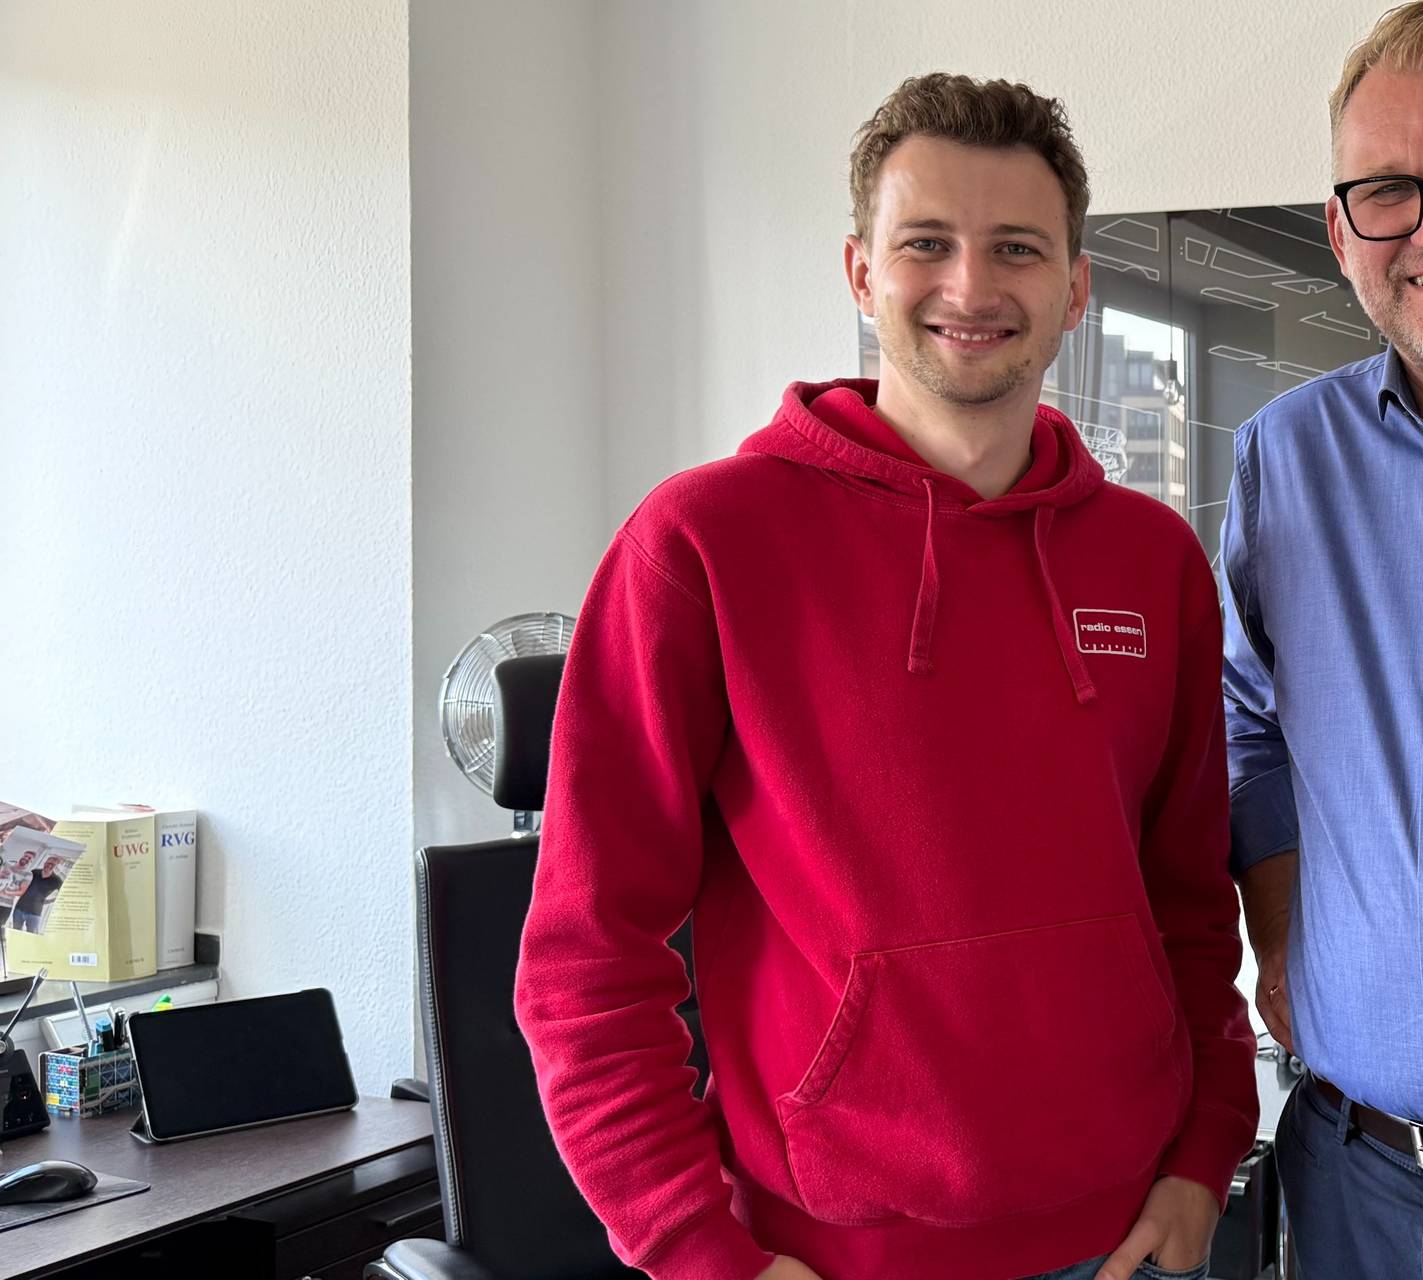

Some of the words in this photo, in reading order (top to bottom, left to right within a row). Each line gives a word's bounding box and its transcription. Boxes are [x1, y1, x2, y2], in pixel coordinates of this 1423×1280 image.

[1080, 622, 1112, 632] radio
[1113, 625, 1143, 636] essen
[161, 832, 195, 848] RVG
[113, 842, 149, 858] UWG
